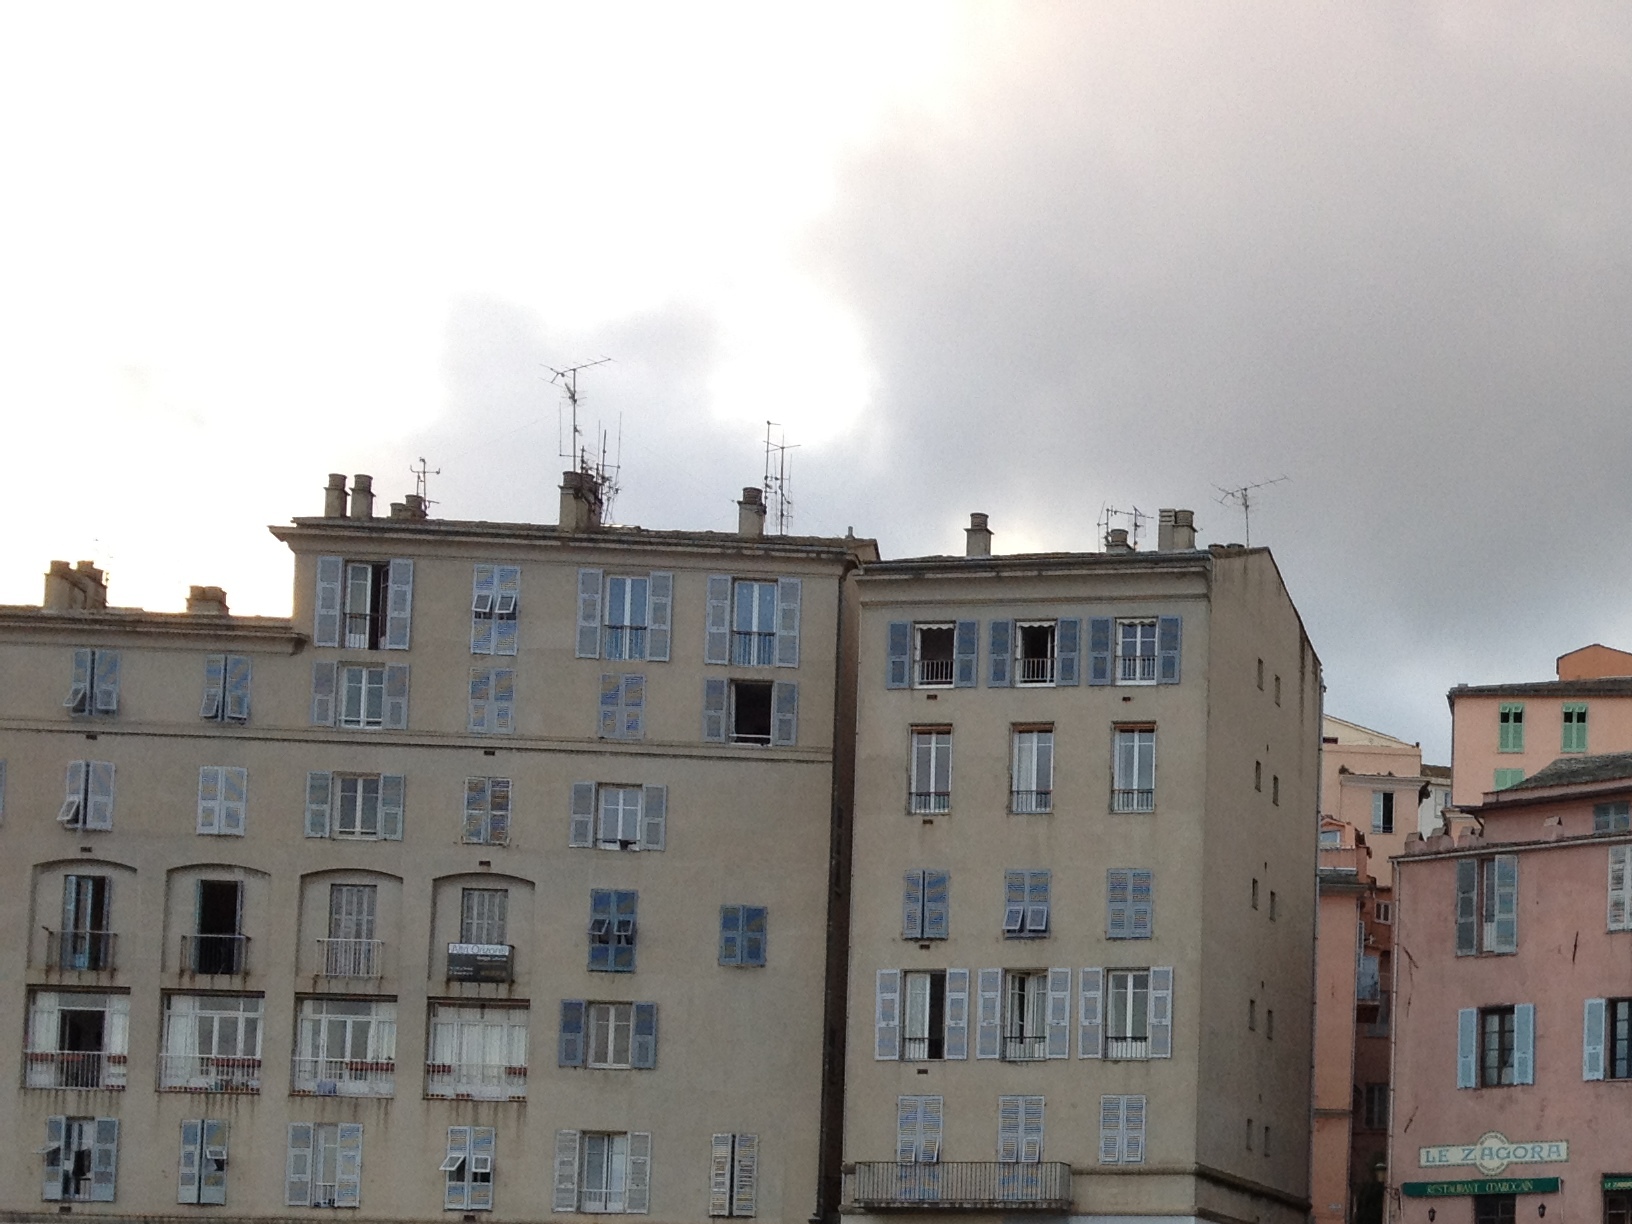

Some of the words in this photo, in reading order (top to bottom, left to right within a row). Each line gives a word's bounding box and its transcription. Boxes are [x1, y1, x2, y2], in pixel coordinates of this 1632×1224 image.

[1425, 1150, 1449, 1163] LE
[1461, 1144, 1562, 1162] ZAGORA
[1426, 1182, 1478, 1194] RESTAURANT
